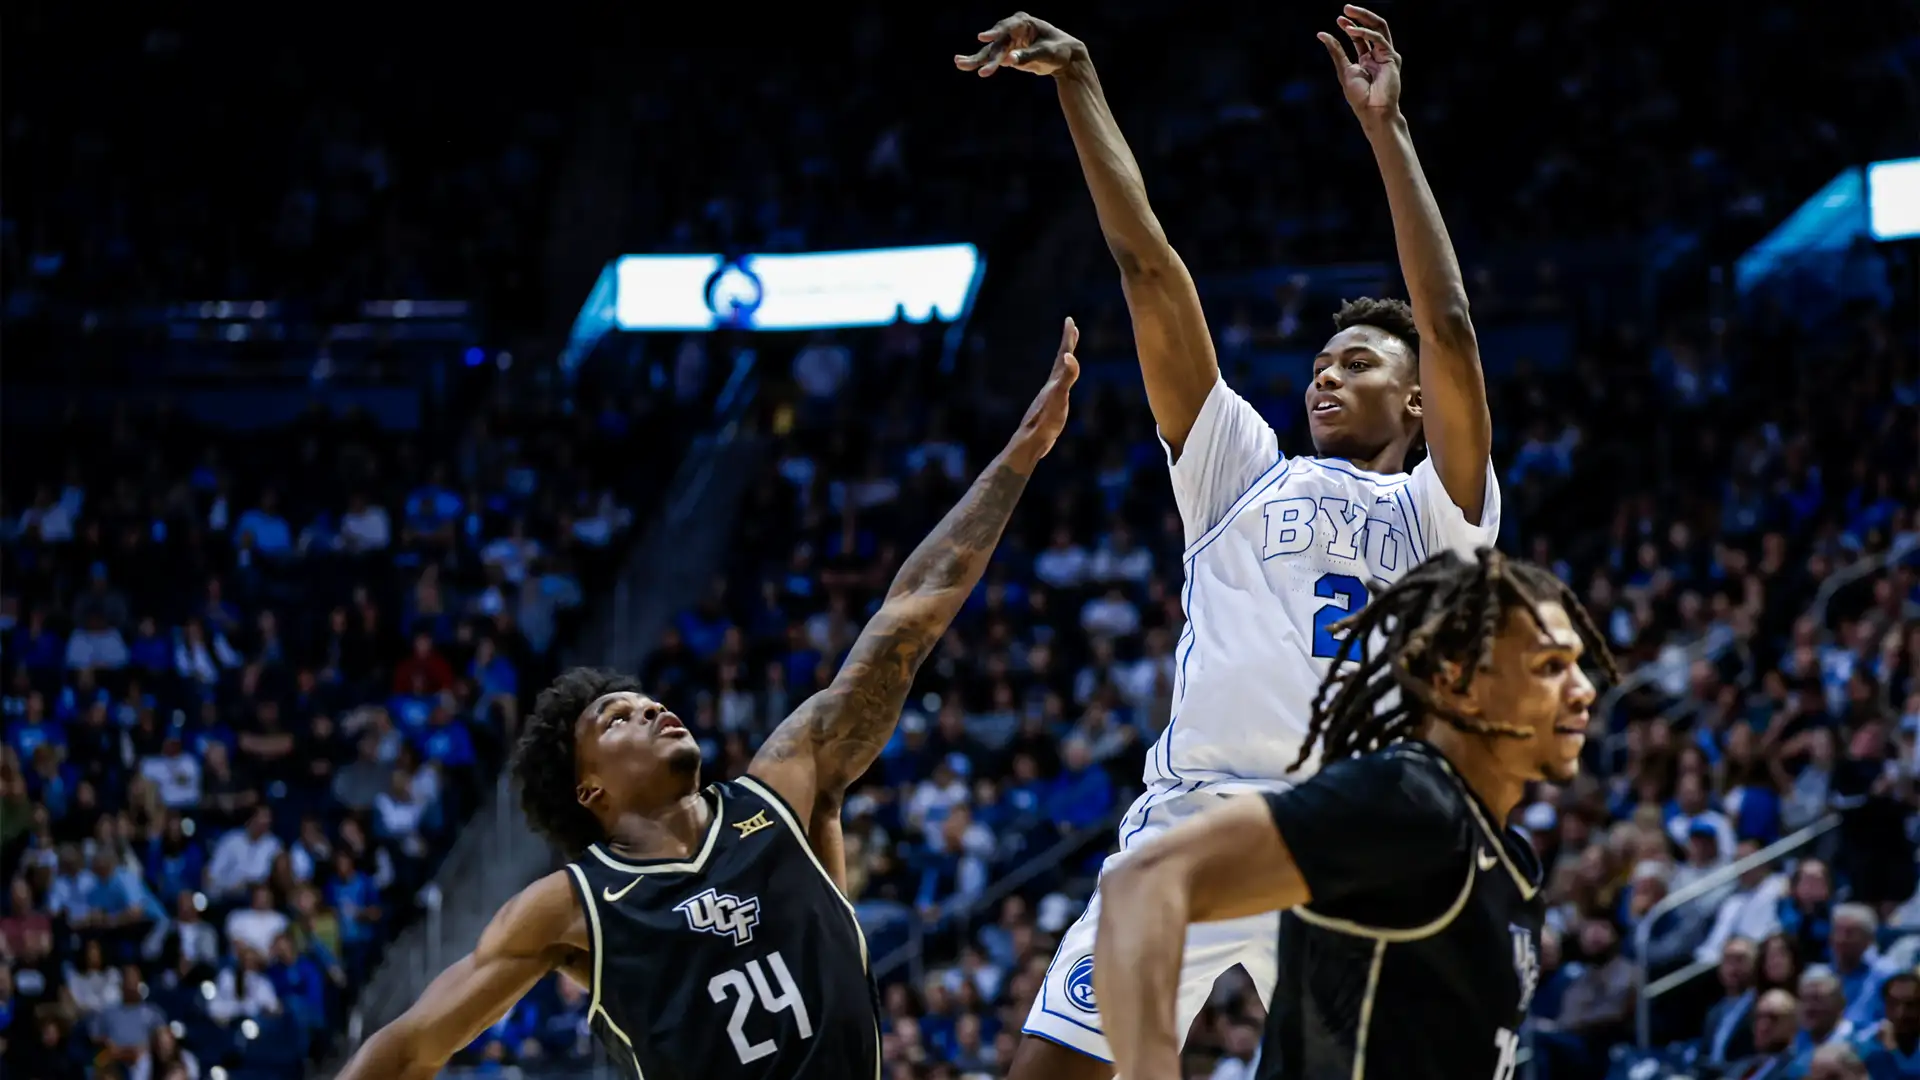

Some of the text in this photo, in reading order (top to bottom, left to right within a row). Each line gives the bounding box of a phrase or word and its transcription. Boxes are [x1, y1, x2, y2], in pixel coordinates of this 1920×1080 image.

[1263, 497, 1407, 585] BYU
[1312, 572, 1369, 662] 2
[672, 888, 760, 947] UCF
[707, 951, 813, 1065] 24
